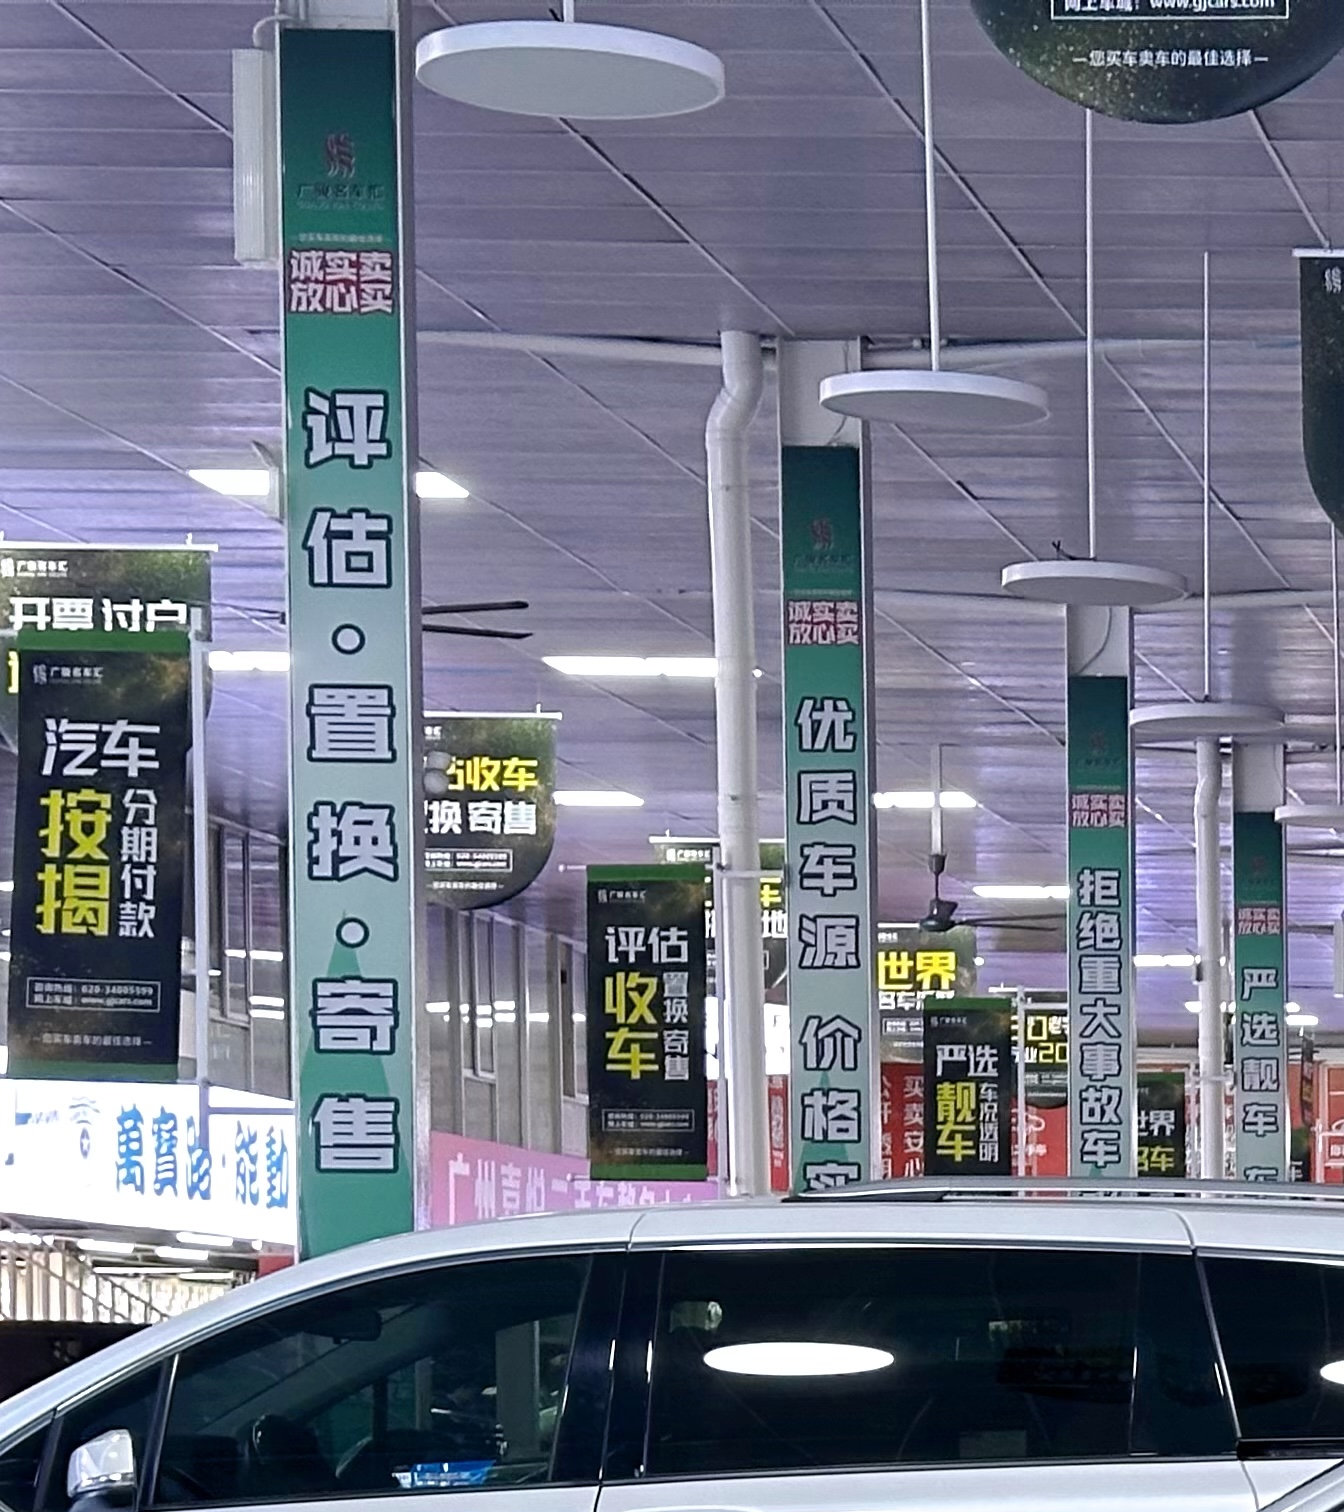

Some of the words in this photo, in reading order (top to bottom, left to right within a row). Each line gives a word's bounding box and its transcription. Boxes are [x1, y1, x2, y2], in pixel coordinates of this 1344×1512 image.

[290, 250, 393, 281] 诚实卖
[290, 282, 393, 313] 放心买
[9, 597, 94, 631] 开票
[788, 601, 859, 622] 诚实卖
[788, 622, 859, 645] 放心买
[42, 718, 161, 778] 汽车
[424, 756, 539, 792] 收车
[424, 800, 462, 835] 换
[467, 800, 537, 835] 寄售
[796, 696, 862, 970] 优质车源
[35, 788, 112, 937] 按揭
[119, 788, 158, 938] 分期付款
[605, 926, 689, 964] 评估
[877, 951, 956, 990] 世界
[605, 971, 659, 1081] 收车
[1077, 867, 1123, 1169] 拒绝重大事故车
[935, 1044, 999, 1077] 严选
[1241, 966, 1280, 1137] 严选靓车
[935, 1081, 976, 1162] 靓车
[978, 1082, 999, 1163] 车况透明
